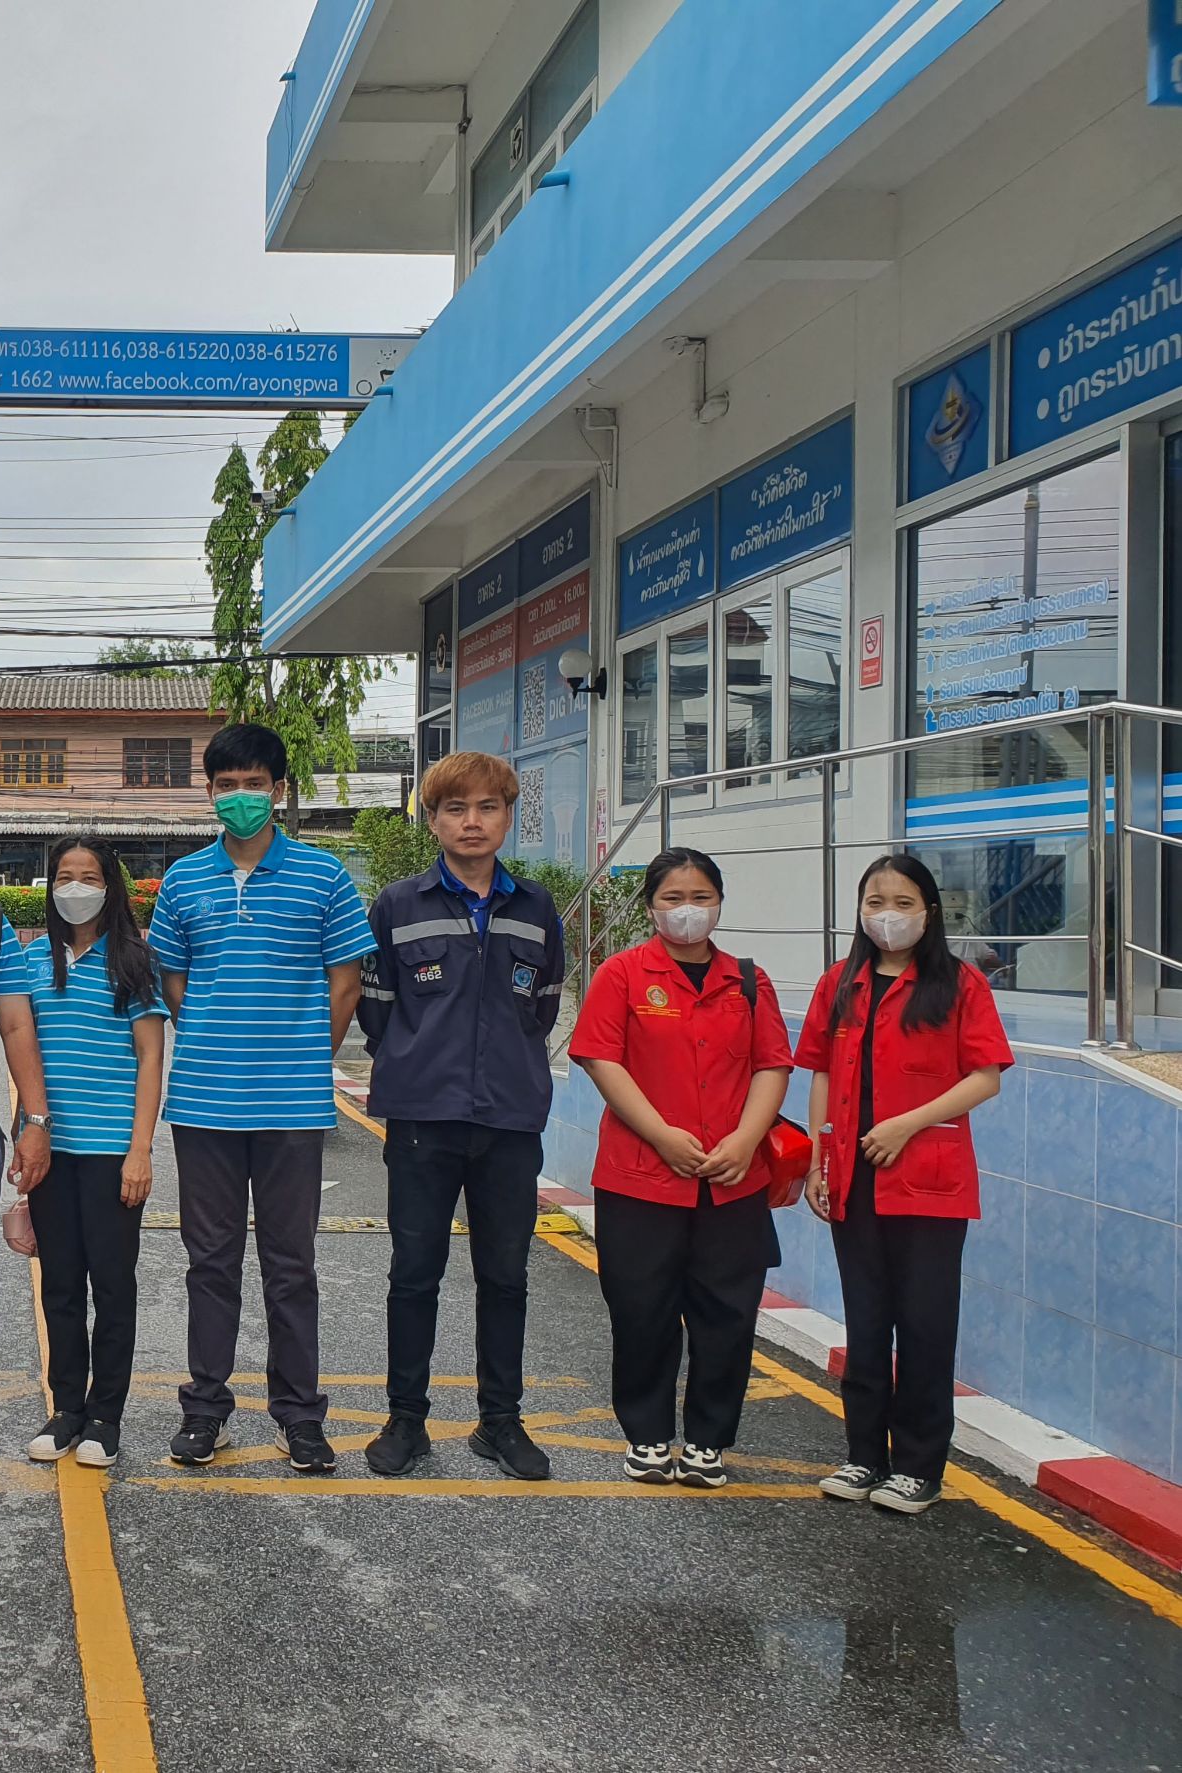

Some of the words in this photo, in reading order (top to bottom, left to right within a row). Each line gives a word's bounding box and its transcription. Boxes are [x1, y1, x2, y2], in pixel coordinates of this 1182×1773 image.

[11, 370, 53, 389] 1662
[59, 370, 338, 397] www.facebook.com/rayongpwa
[542, 535, 564, 565] อาคาร
[567, 527, 573, 551] 2
[497, 573, 502, 594] 2
[549, 692, 587, 721] DIGTAL
[360, 970, 380, 984] PWA
[413, 969, 442, 982] 1662
